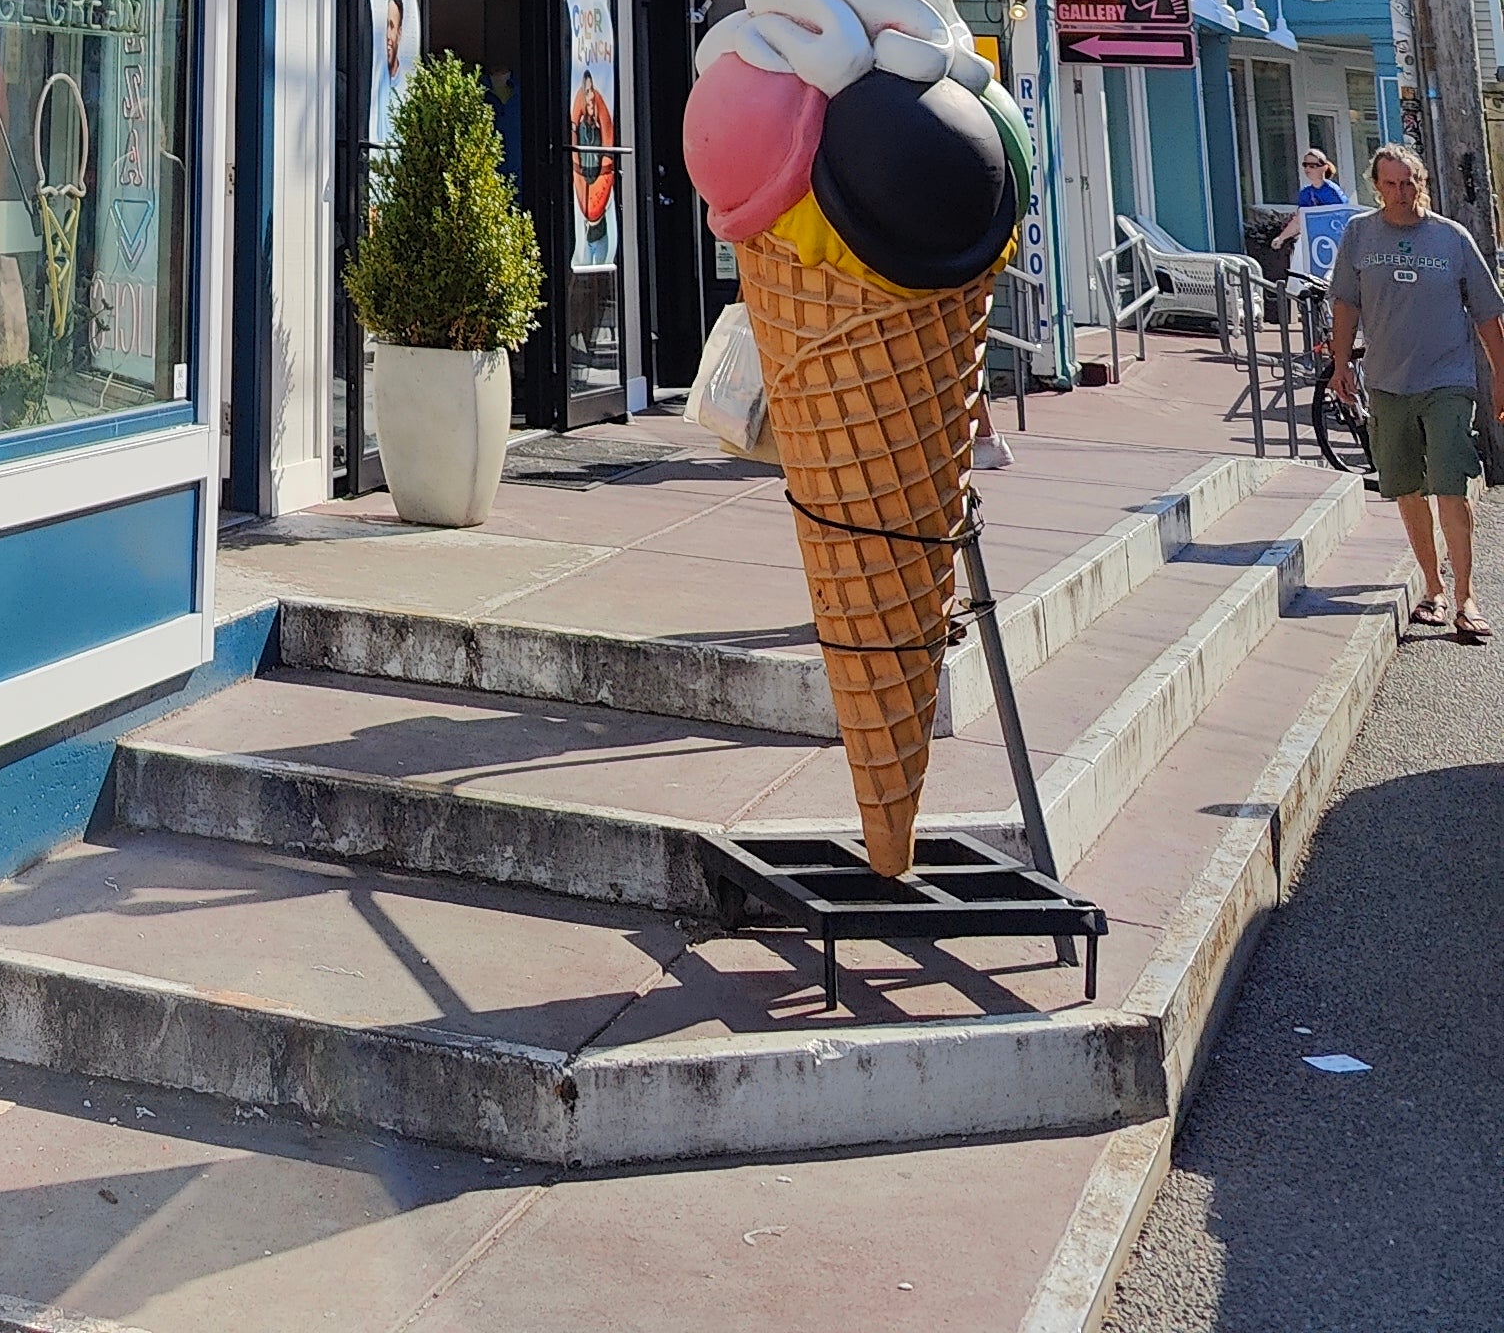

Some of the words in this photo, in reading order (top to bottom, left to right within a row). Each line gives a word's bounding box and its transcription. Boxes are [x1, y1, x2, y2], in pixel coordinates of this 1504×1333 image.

[573, 4, 603, 40] COLOR
[1058, 4, 1127, 21] GALLERY
[577, 35, 612, 66] LAUNCH
[1364, 253, 1414, 267] SLIPPERY
[1417, 256, 1449, 270] ROCK
